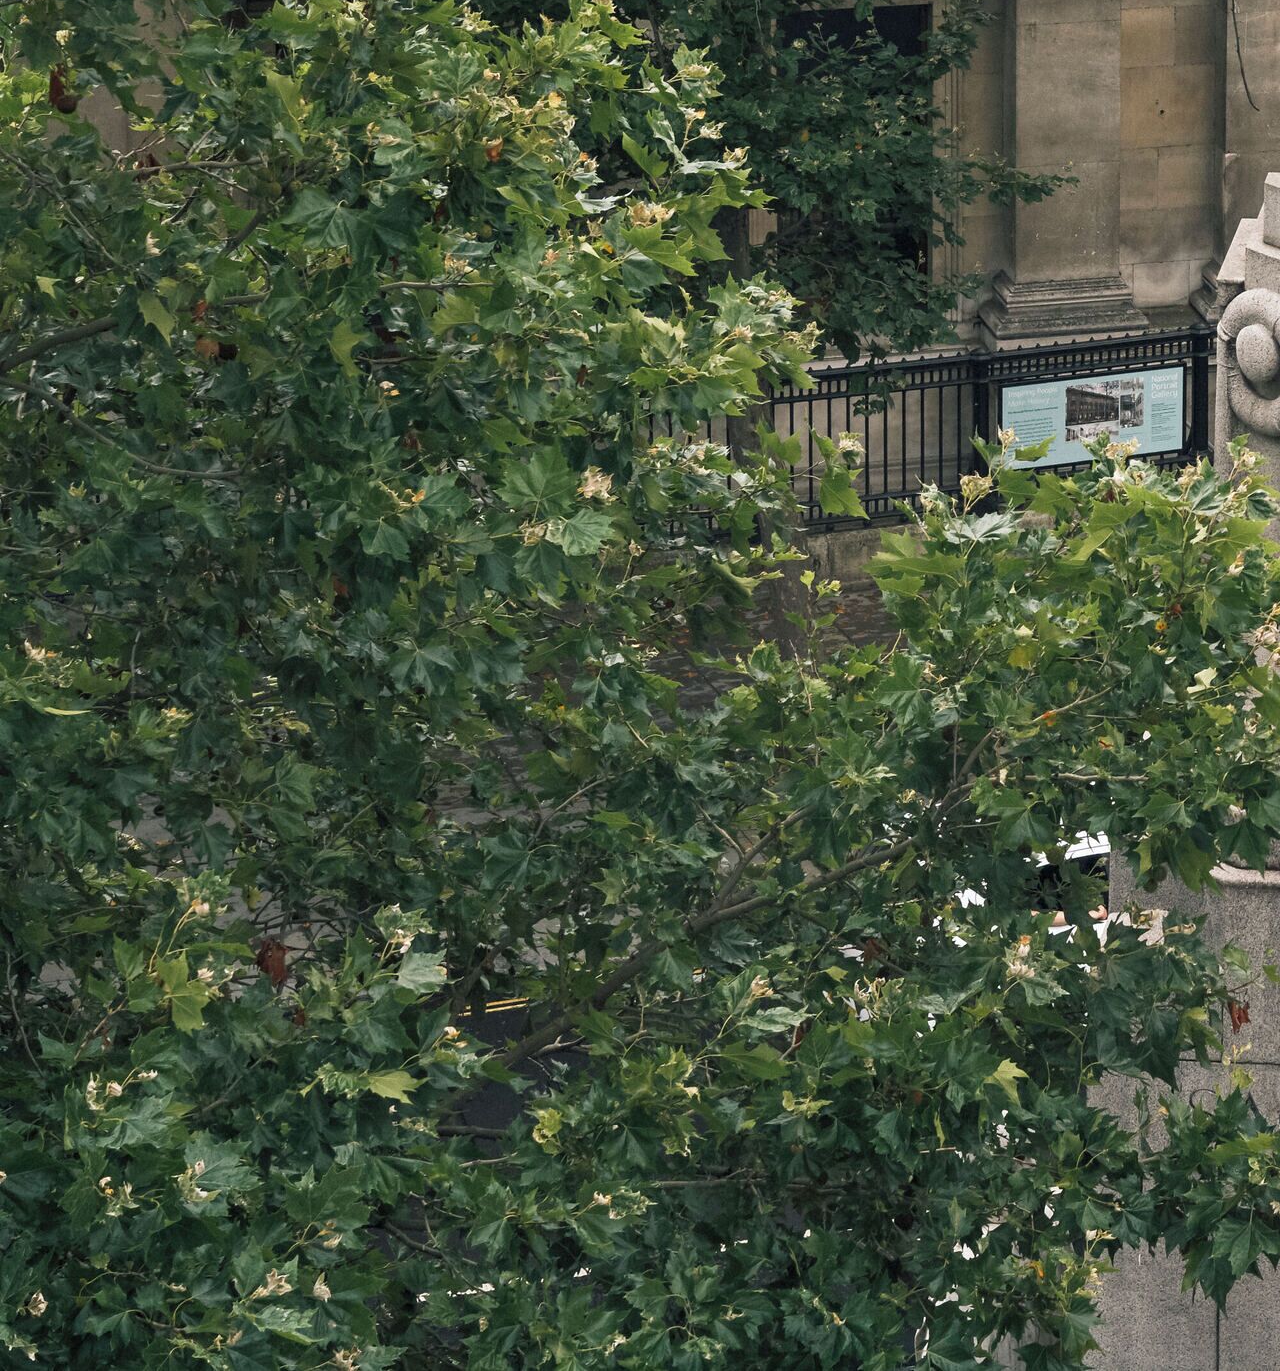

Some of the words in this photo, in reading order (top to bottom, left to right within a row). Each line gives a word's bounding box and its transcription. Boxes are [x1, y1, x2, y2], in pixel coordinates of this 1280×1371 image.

[1151, 372, 1178, 383] National
[1151, 381, 1178, 390] Portrait
[1151, 389, 1178, 399] Gallery
